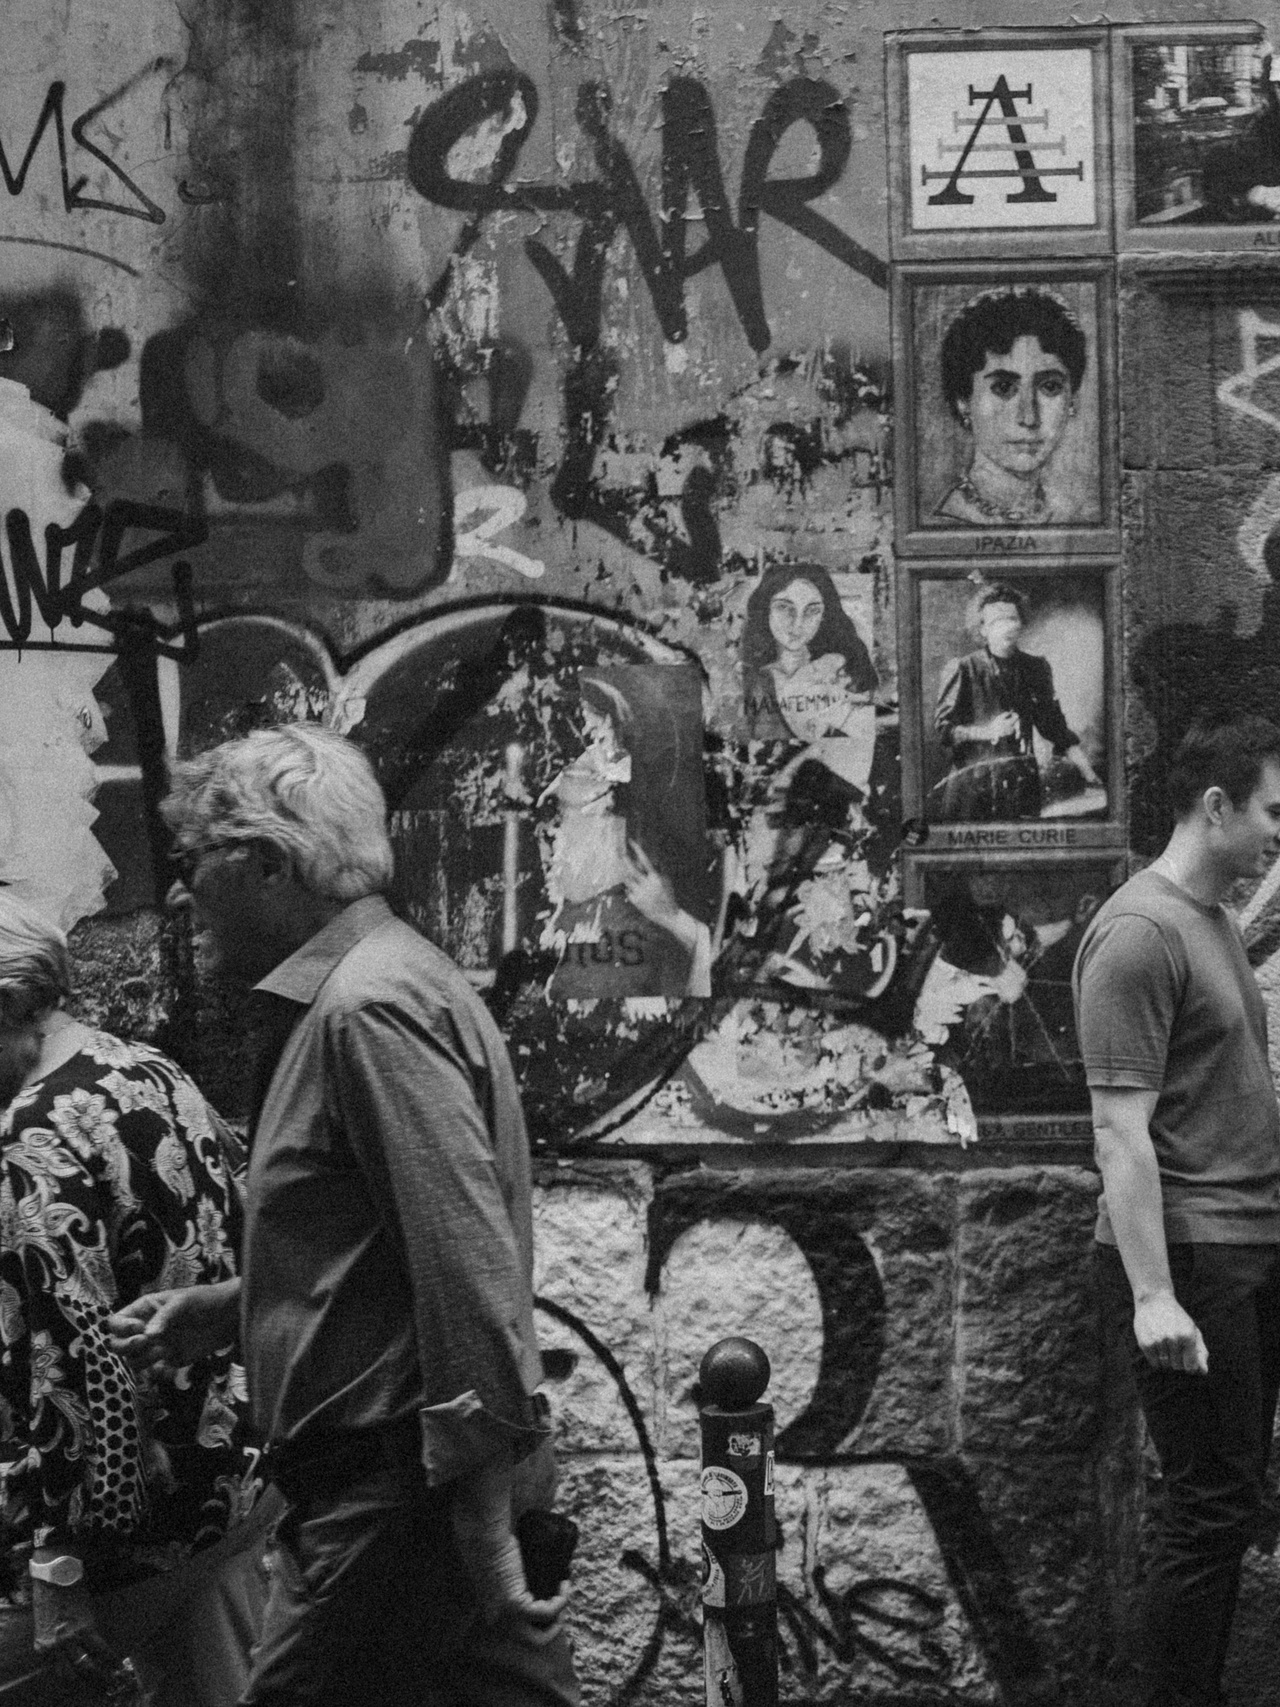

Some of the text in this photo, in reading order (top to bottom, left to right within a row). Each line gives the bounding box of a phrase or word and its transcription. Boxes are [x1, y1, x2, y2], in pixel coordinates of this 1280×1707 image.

[975, 535, 1038, 552] IPAZIA
[947, 828, 1078, 845] MARIE CURIE
